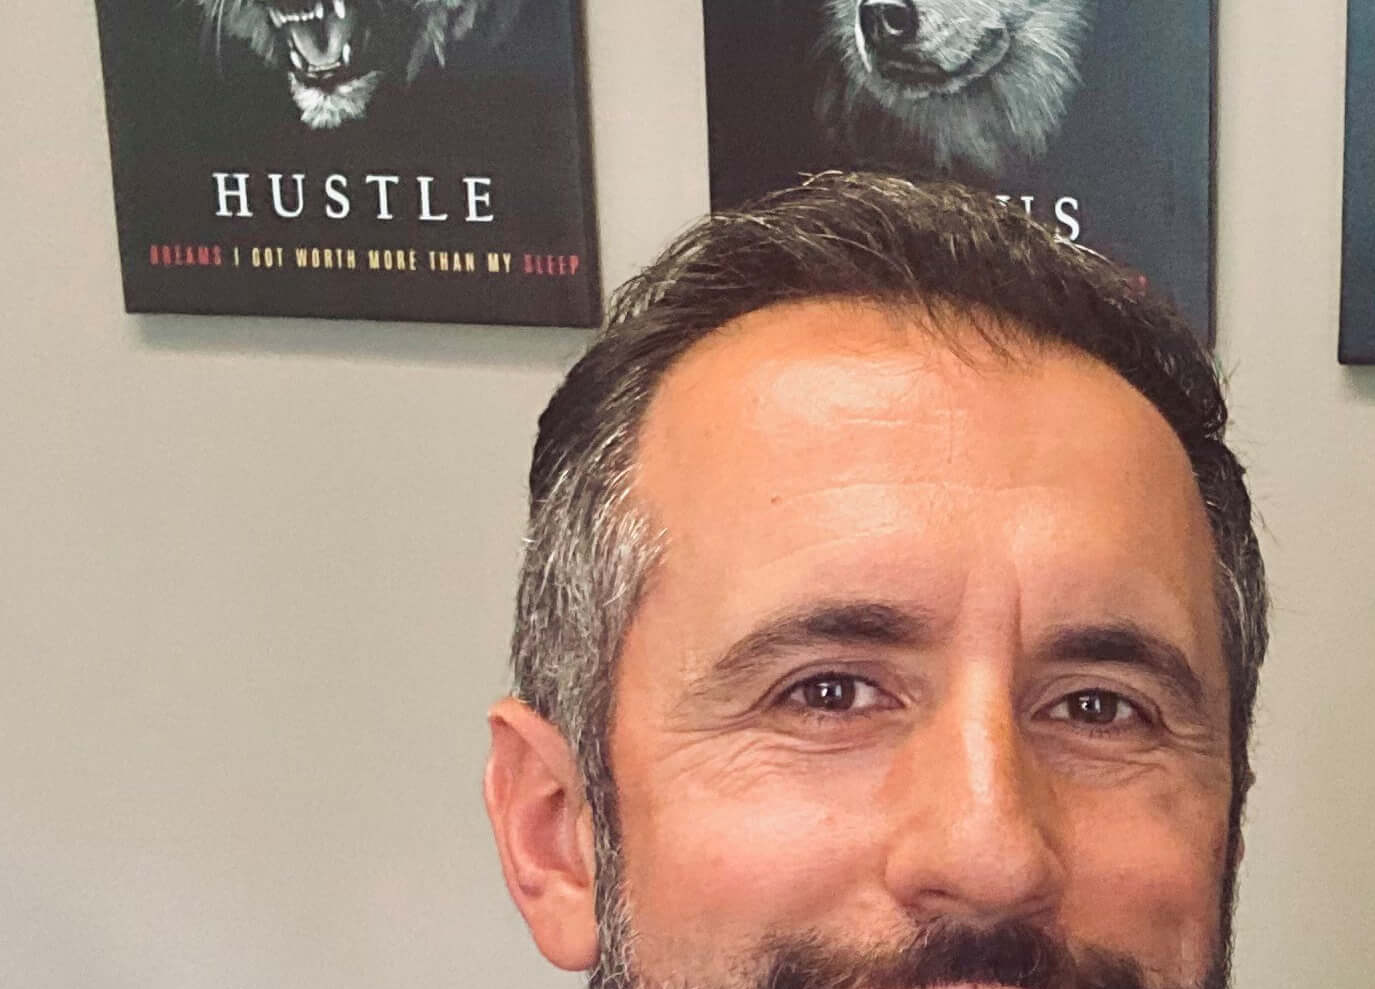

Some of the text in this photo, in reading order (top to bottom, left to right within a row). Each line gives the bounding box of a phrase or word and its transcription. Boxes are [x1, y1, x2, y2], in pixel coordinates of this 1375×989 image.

[211, 172, 495, 222] HUSTLE
[234, 247, 239, 266] I
[296, 247, 356, 269] WORTH
[369, 250, 417, 271] MORE
[429, 251, 475, 272] THAN
[487, 252, 512, 273] MY
